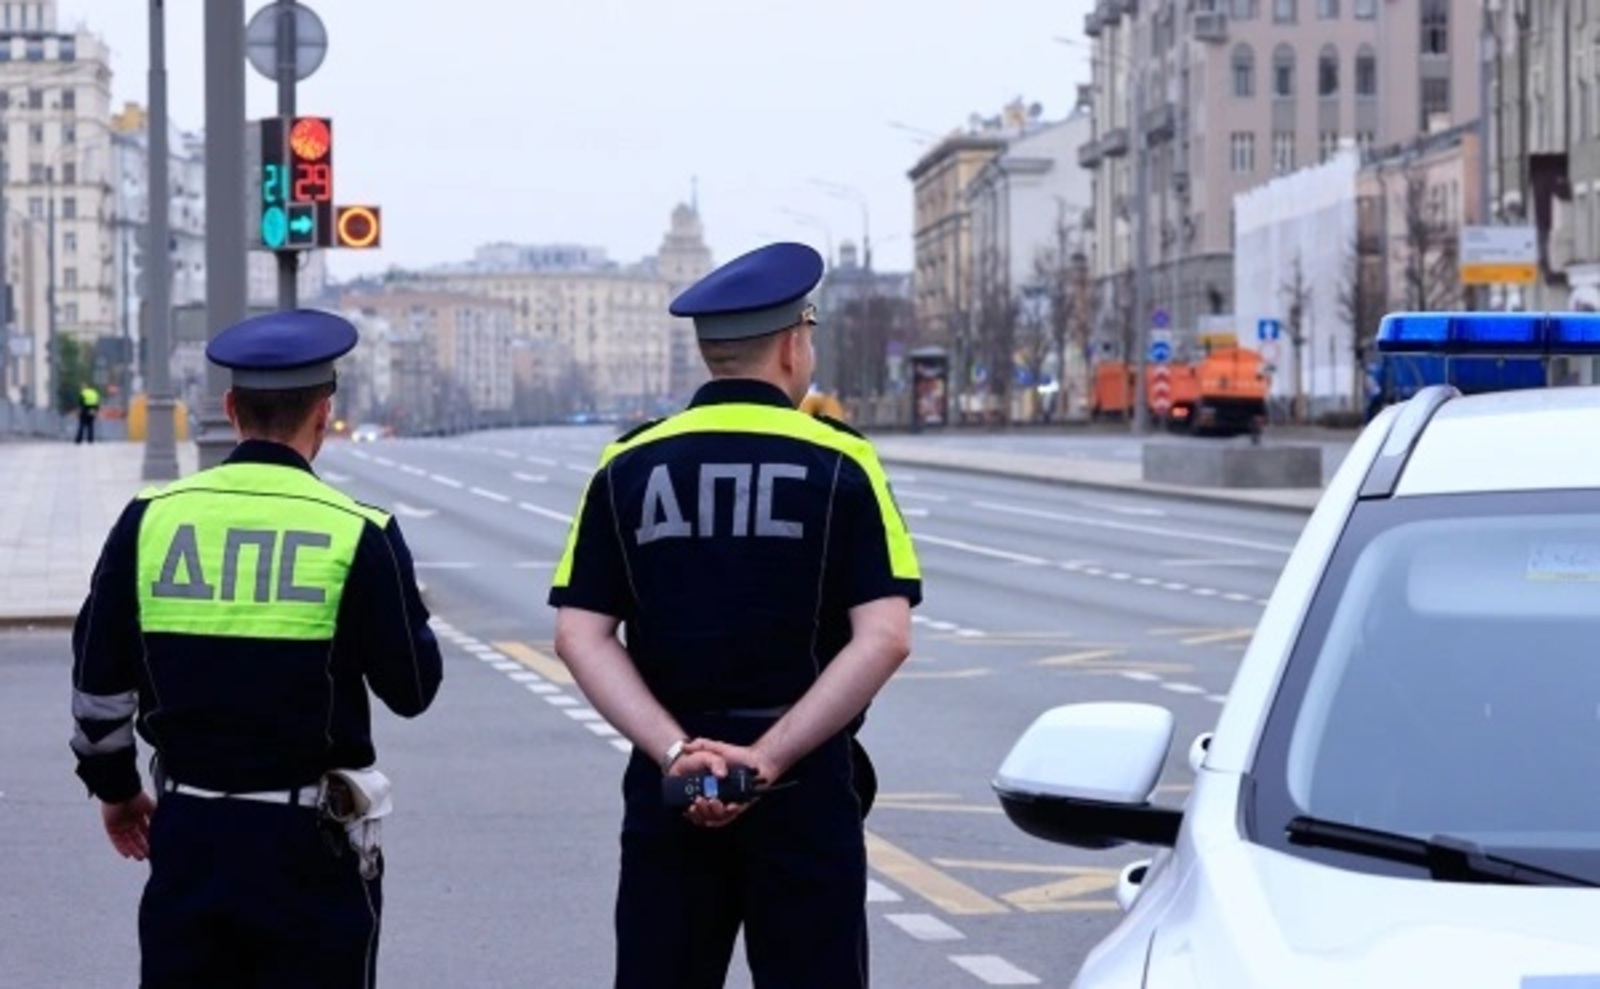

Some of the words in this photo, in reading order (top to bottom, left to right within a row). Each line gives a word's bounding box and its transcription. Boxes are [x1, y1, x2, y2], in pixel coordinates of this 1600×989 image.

[295, 163, 331, 202] 29
[635, 463, 807, 545] ДПС
[152, 524, 331, 603] ДПС
